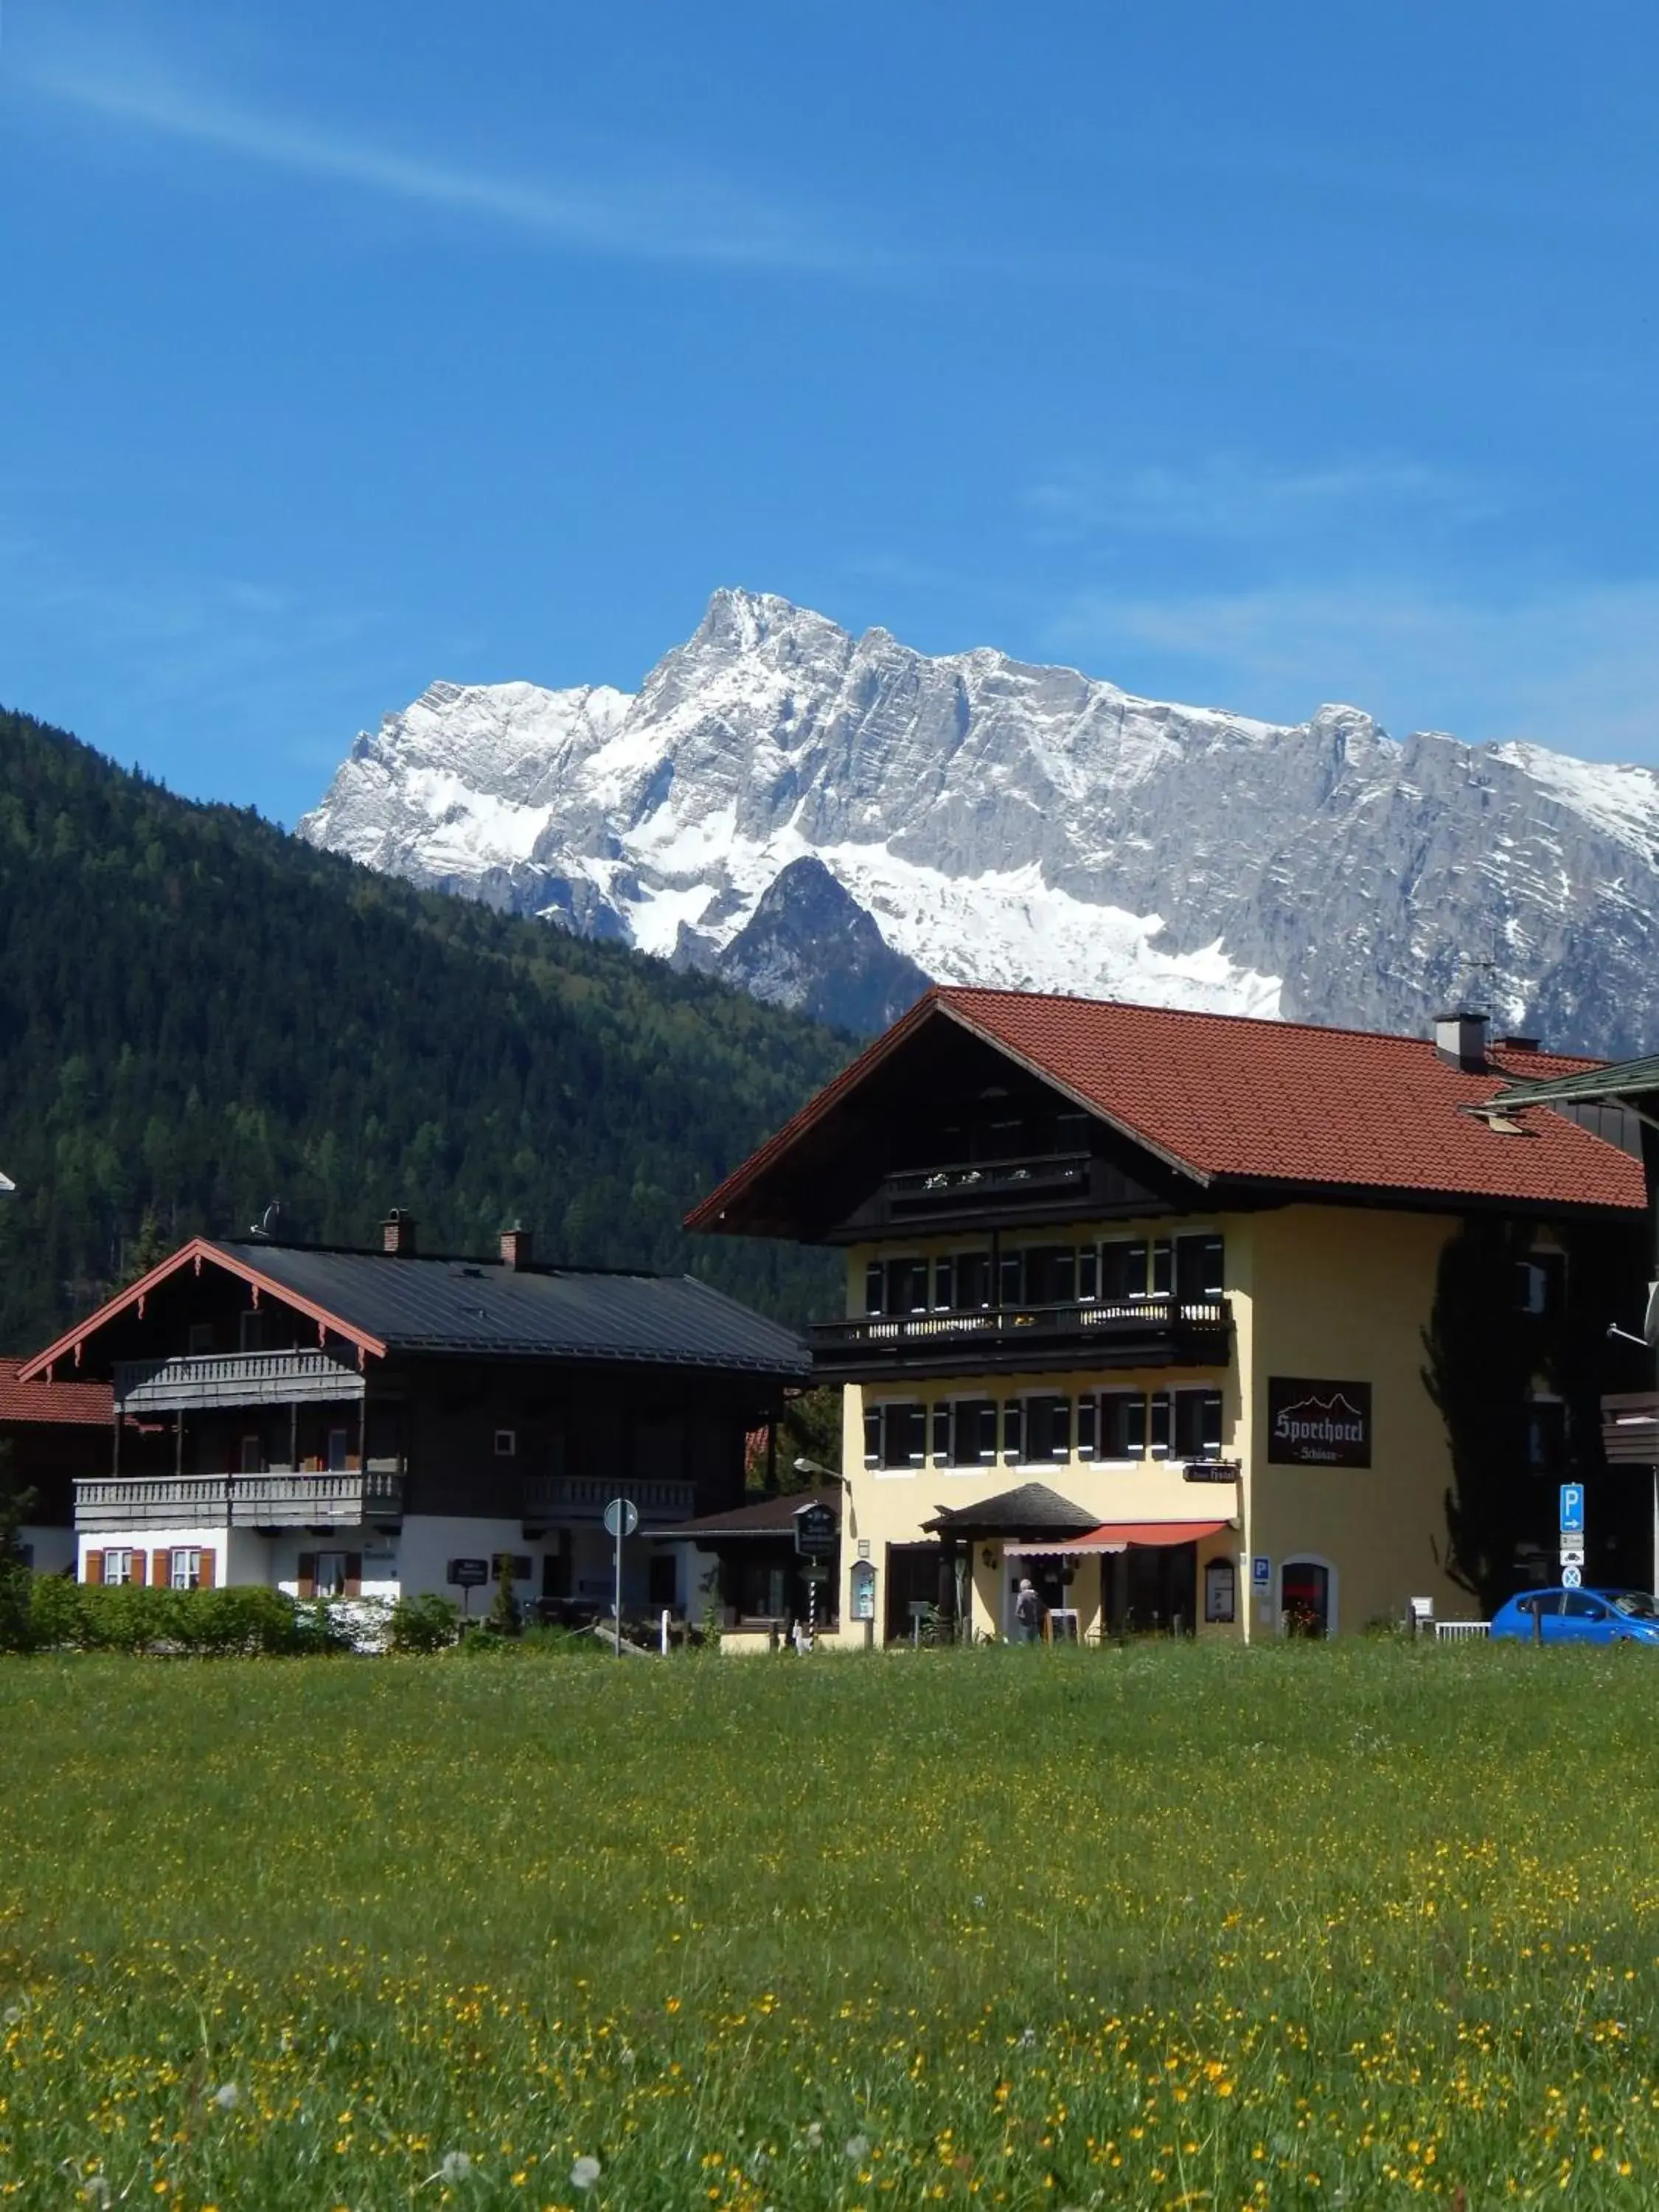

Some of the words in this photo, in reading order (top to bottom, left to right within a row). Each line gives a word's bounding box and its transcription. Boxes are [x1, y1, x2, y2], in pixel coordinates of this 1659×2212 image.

[1274, 1414, 1363, 1443] Sporthotel
[1565, 1489, 1579, 1517] P
[1256, 1561, 1267, 1576] P
